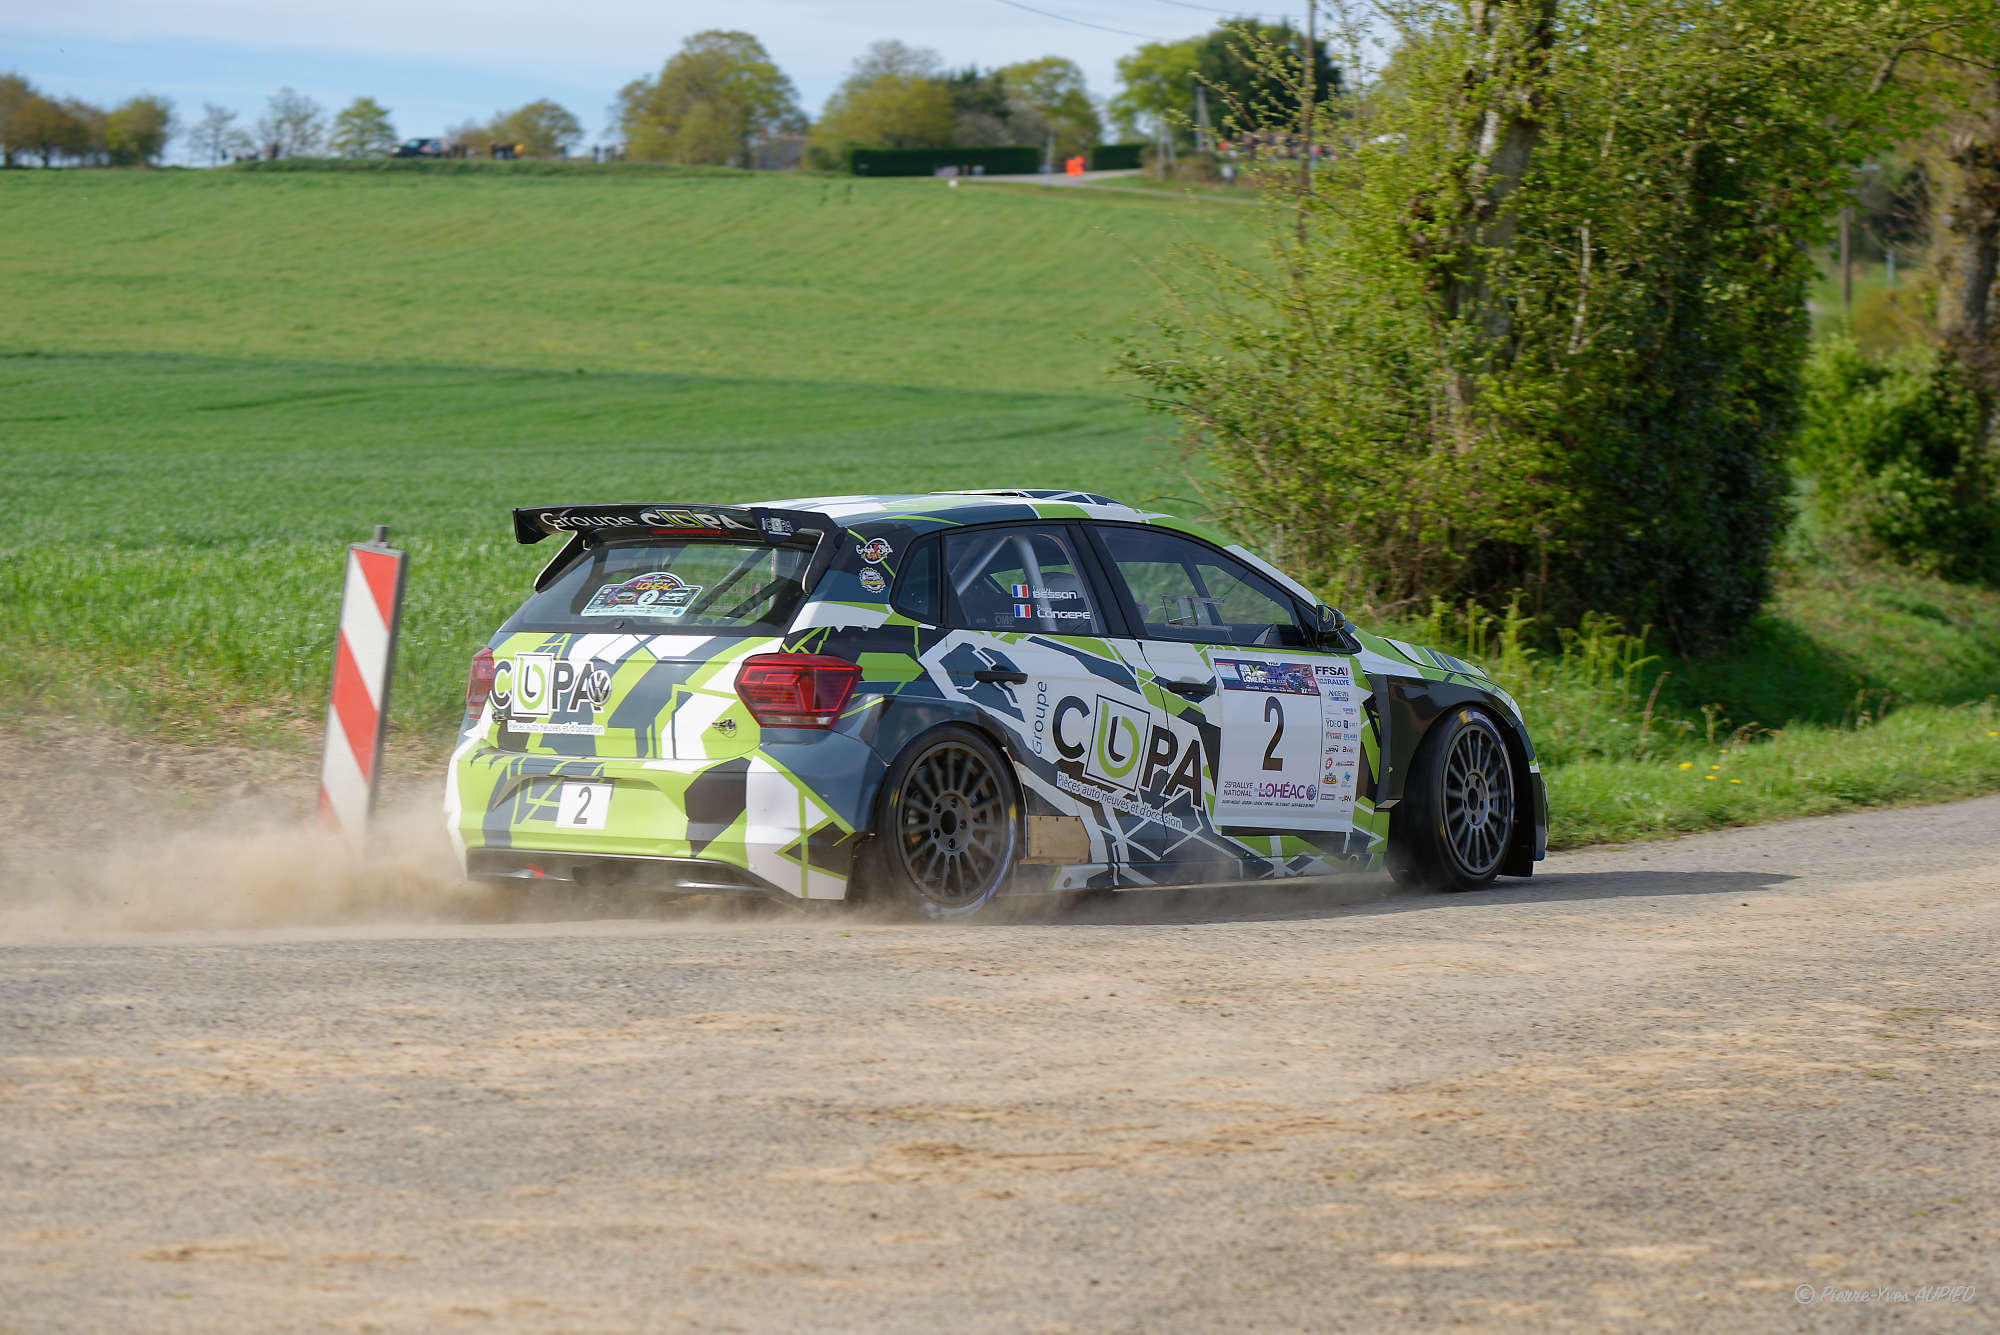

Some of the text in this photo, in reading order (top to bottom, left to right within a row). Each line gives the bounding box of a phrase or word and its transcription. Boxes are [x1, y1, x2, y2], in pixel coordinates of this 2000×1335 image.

[539, 509, 636, 530] Groupe
[1315, 666, 1345, 676] FFSA
[1032, 680, 1049, 755] Groupe
[1262, 696, 1284, 771] 2
[573, 786, 592, 824] 2
[1057, 773, 1081, 792] Pièces
[1082, 785, 1100, 800] auto
[1101, 793, 1129, 810] neuves
[1140, 805, 1182, 829] d'occasion
[1223, 789, 1252, 797] NATIONAL
[1258, 782, 1305, 799] LOHÉAC
